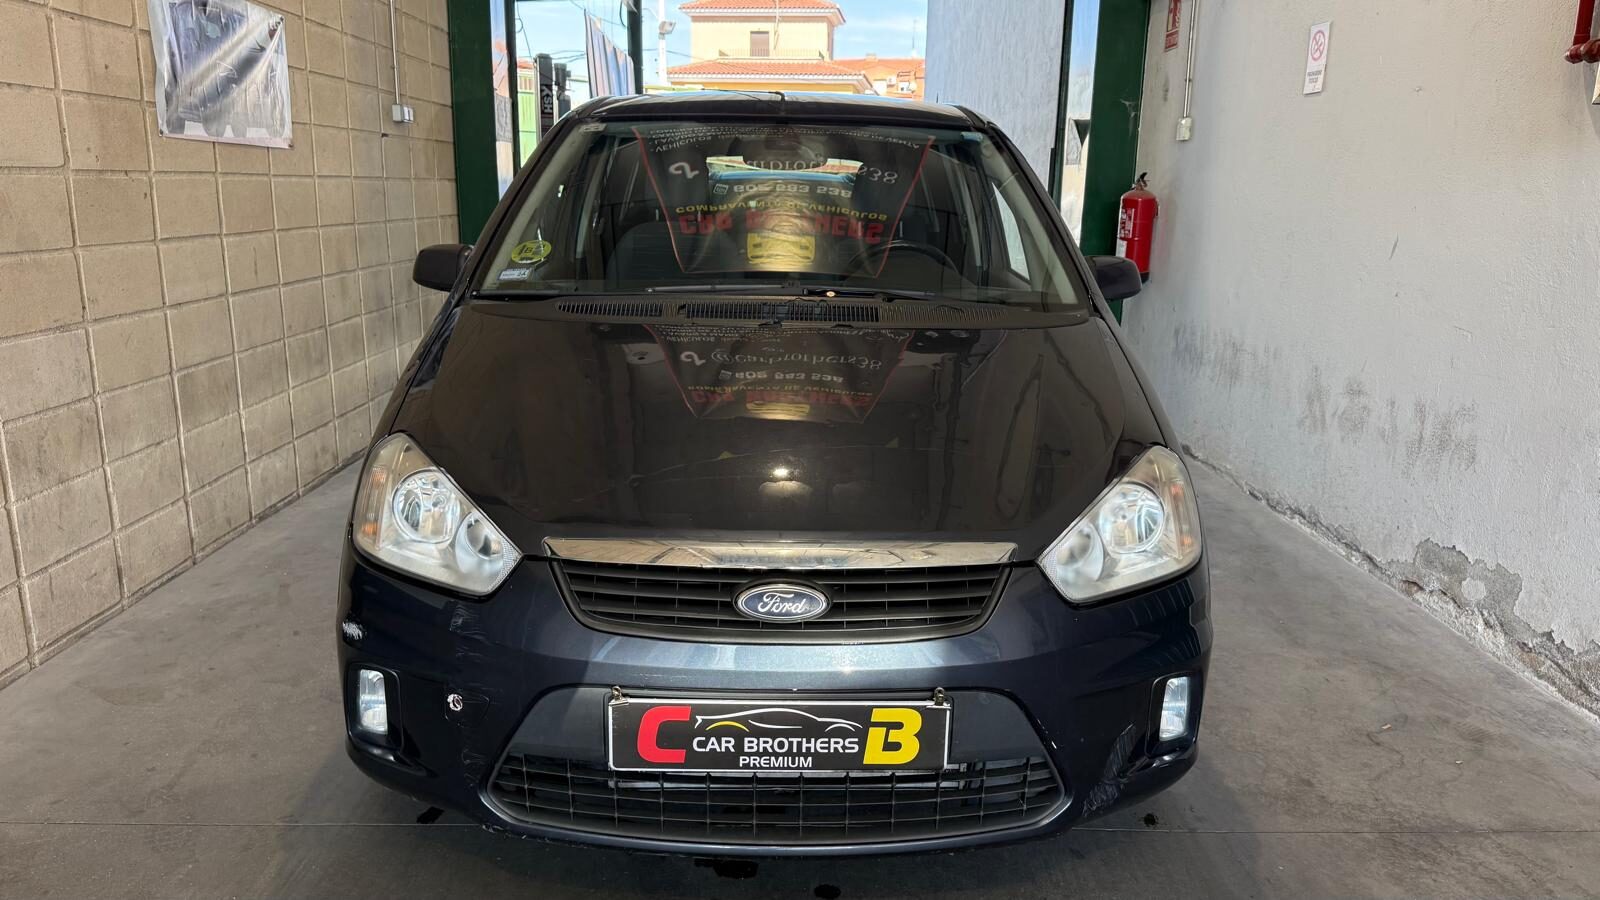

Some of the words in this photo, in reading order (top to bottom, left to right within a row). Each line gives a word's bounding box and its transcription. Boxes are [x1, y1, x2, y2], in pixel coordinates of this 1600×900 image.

[757, 592, 806, 613] Ford
[637, 705, 691, 763] C
[692, 736, 735, 753] CAR
[743, 737, 859, 753] BROTHERS
[863, 707, 922, 765] B
[740, 756, 812, 768] PREMIUM
